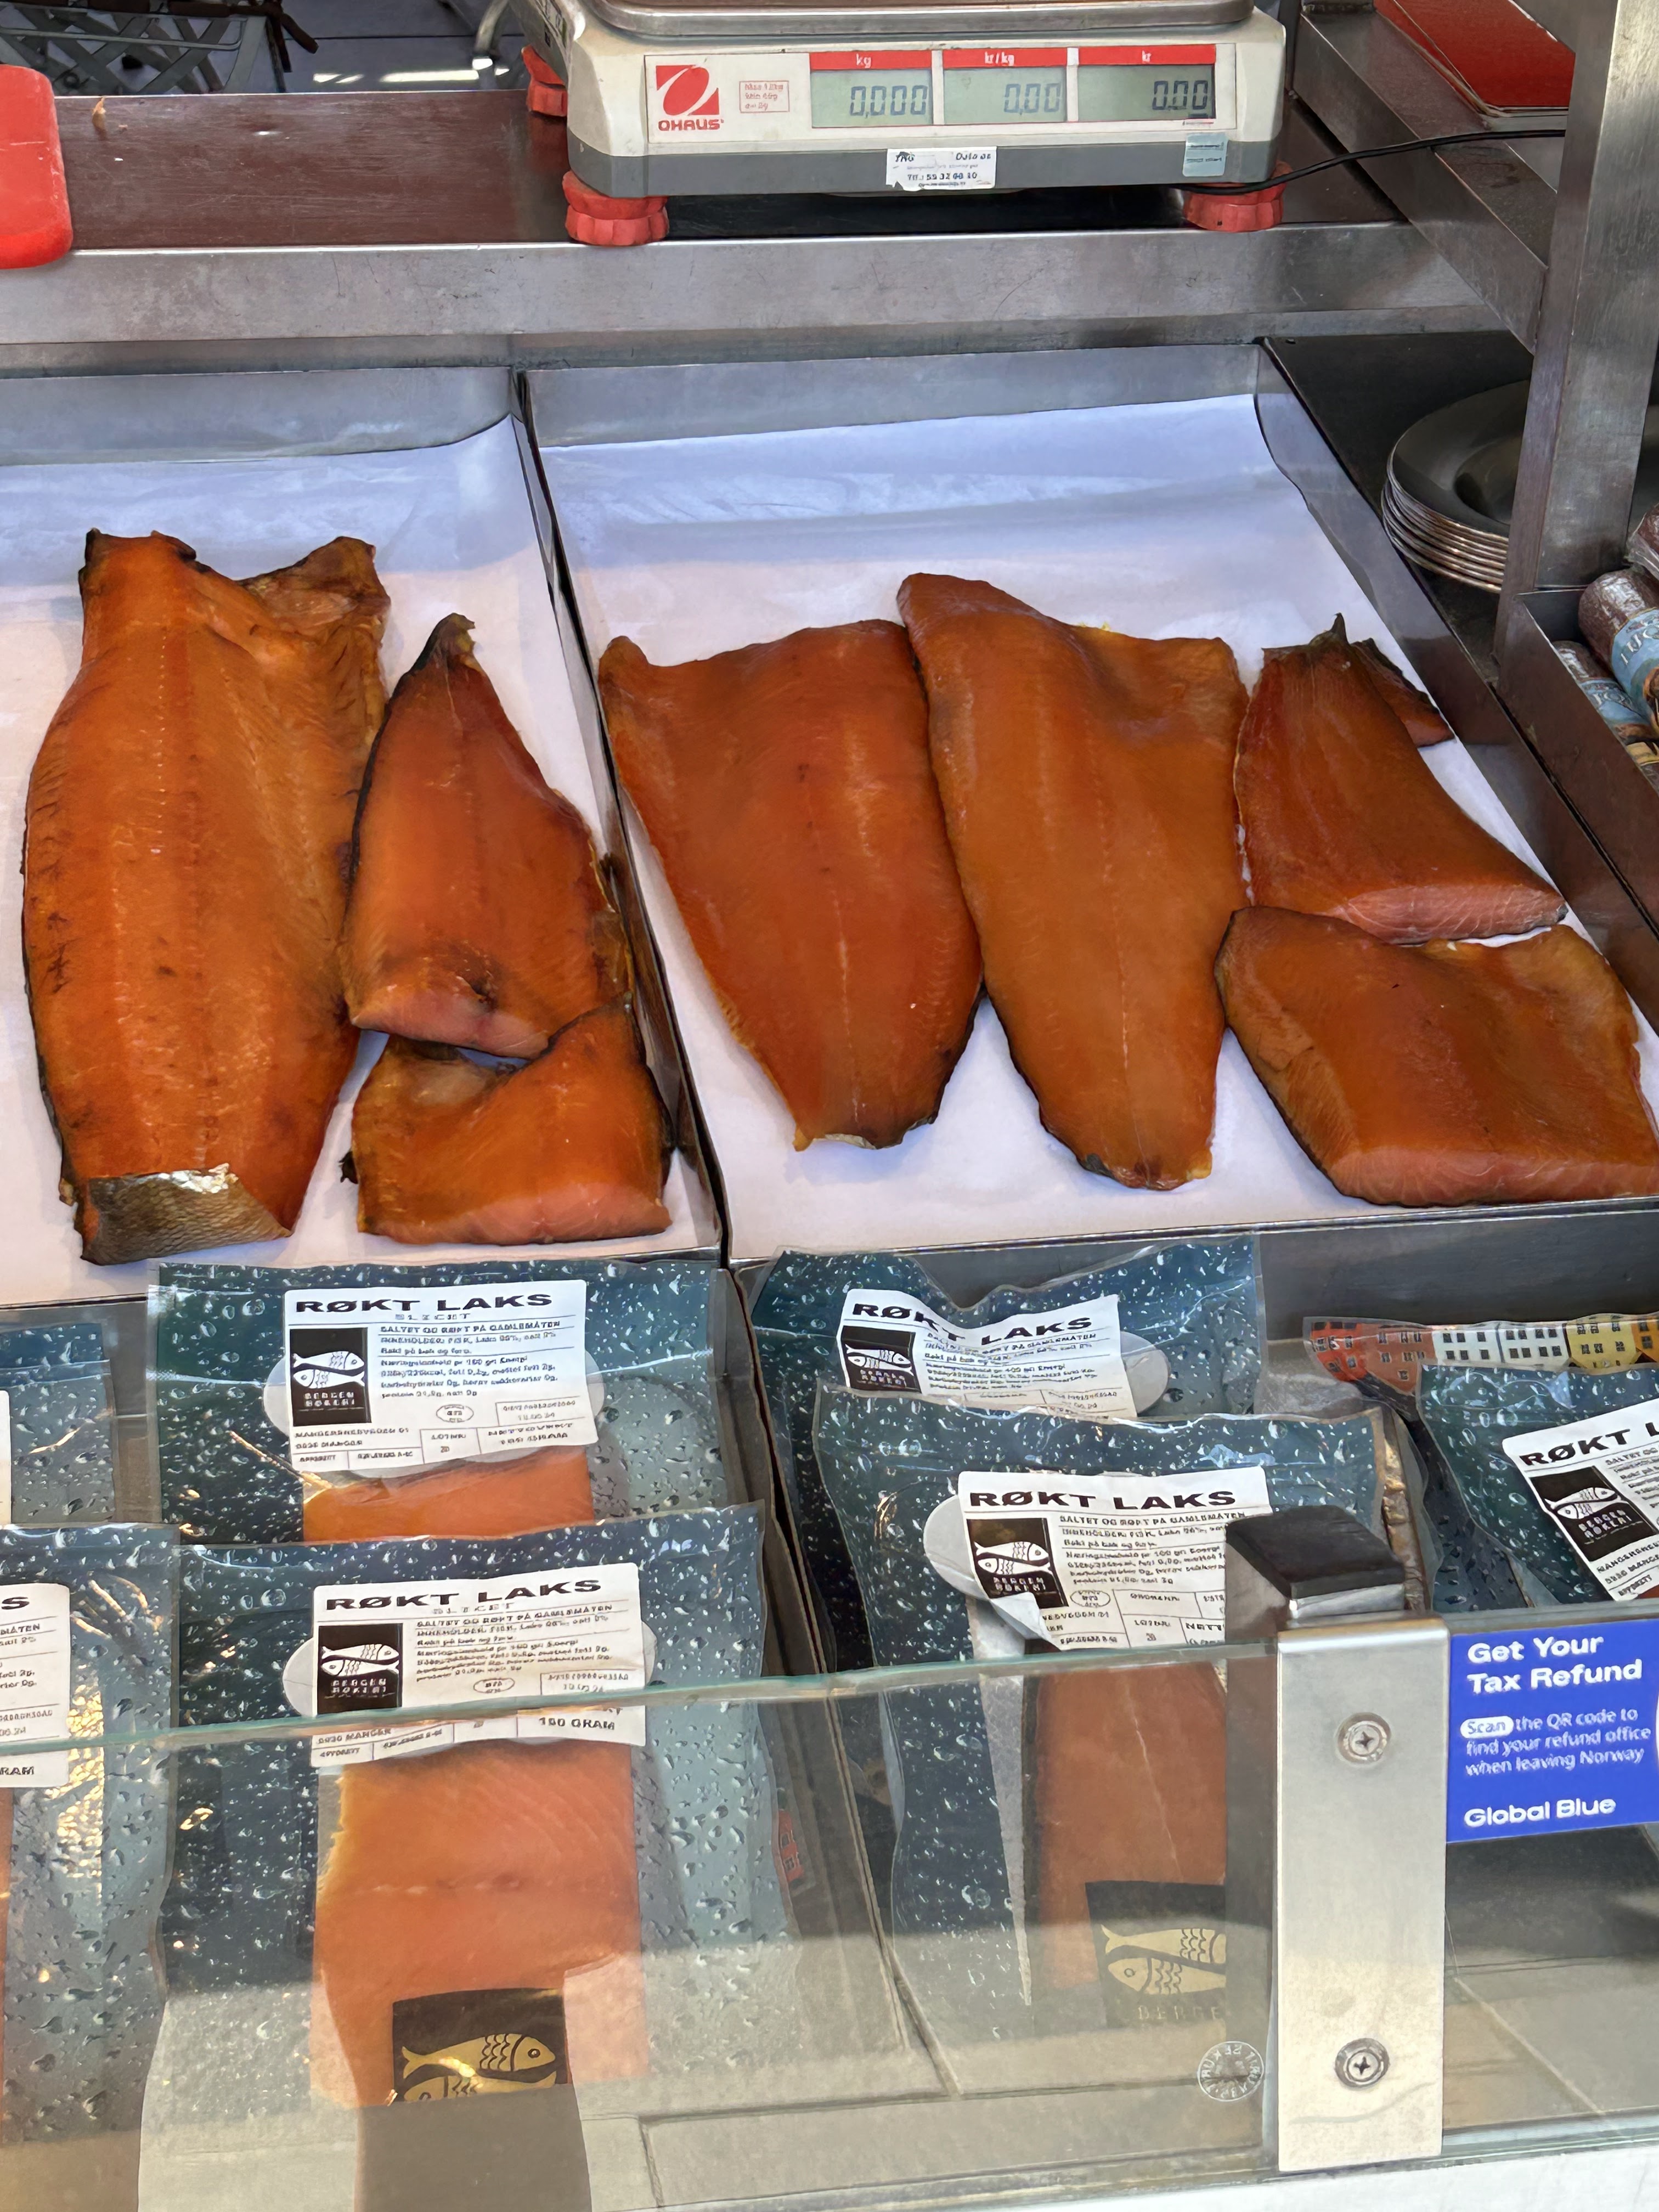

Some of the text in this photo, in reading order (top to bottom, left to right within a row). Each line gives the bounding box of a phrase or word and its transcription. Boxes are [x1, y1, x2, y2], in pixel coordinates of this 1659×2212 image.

[856, 54, 872, 68] kg
[1142, 51, 1151, 63] kr
[658, 119, 721, 131] OHAUS
[296, 1293, 552, 1313] RØKT LAKS
[852, 1303, 966, 1342] RØKT
[981, 1317, 1091, 1346] LAKS
[1519, 1429, 1630, 1466] RØKT
[969, 1490, 1235, 1509] RØKT LAKS
[326, 1579, 601, 1610] RØKT LAKS
[1468, 1636, 1604, 1664] Get Your
[1467, 1658, 1643, 1694] Tax Refund
[1468, 1708, 1639, 1735] Scan the QR code to
[1466, 1725, 1652, 1758] find your refund office
[1465, 1747, 1645, 1777] when leaving Norway
[1464, 1798, 1617, 1827] Global Blue
